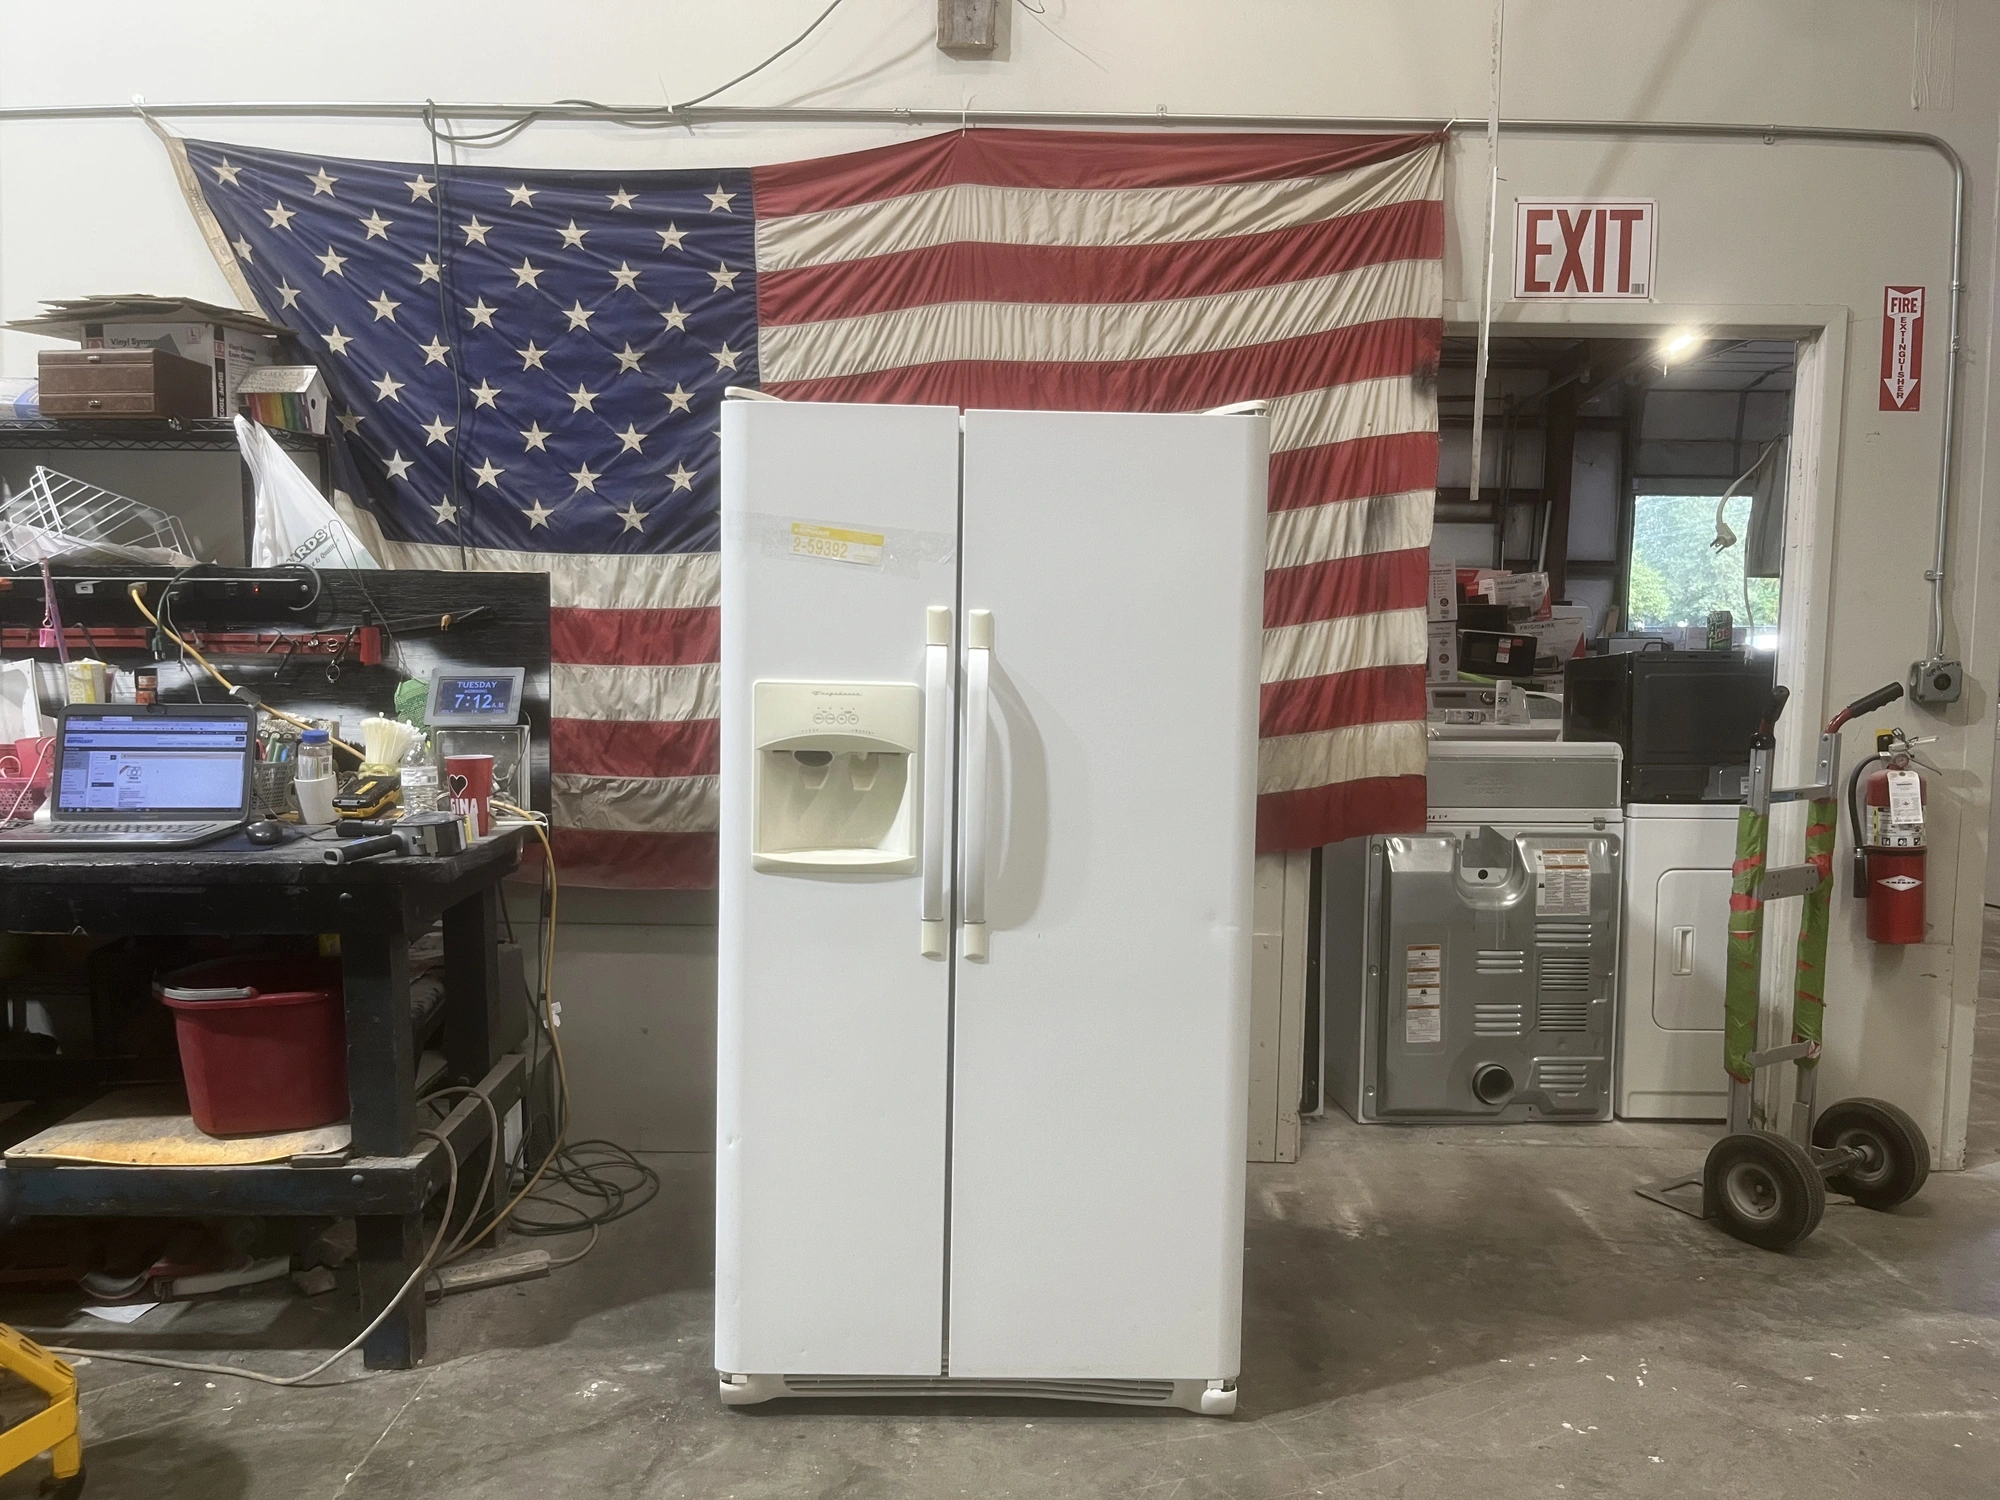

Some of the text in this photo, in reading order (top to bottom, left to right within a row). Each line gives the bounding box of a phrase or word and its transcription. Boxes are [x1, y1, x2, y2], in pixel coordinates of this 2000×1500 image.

[1524, 209, 1644, 293] EXIT
[1890, 297, 1918, 313] FIRE
[111, 338, 130, 347] Vinyl
[1896, 316, 1907, 399] EXTINGUISHER
[286, 529, 327, 562] ARDS
[793, 536, 848, 558] 2-59392
[457, 681, 497, 689] TUESDAY
[455, 694, 493, 709] 7:12
